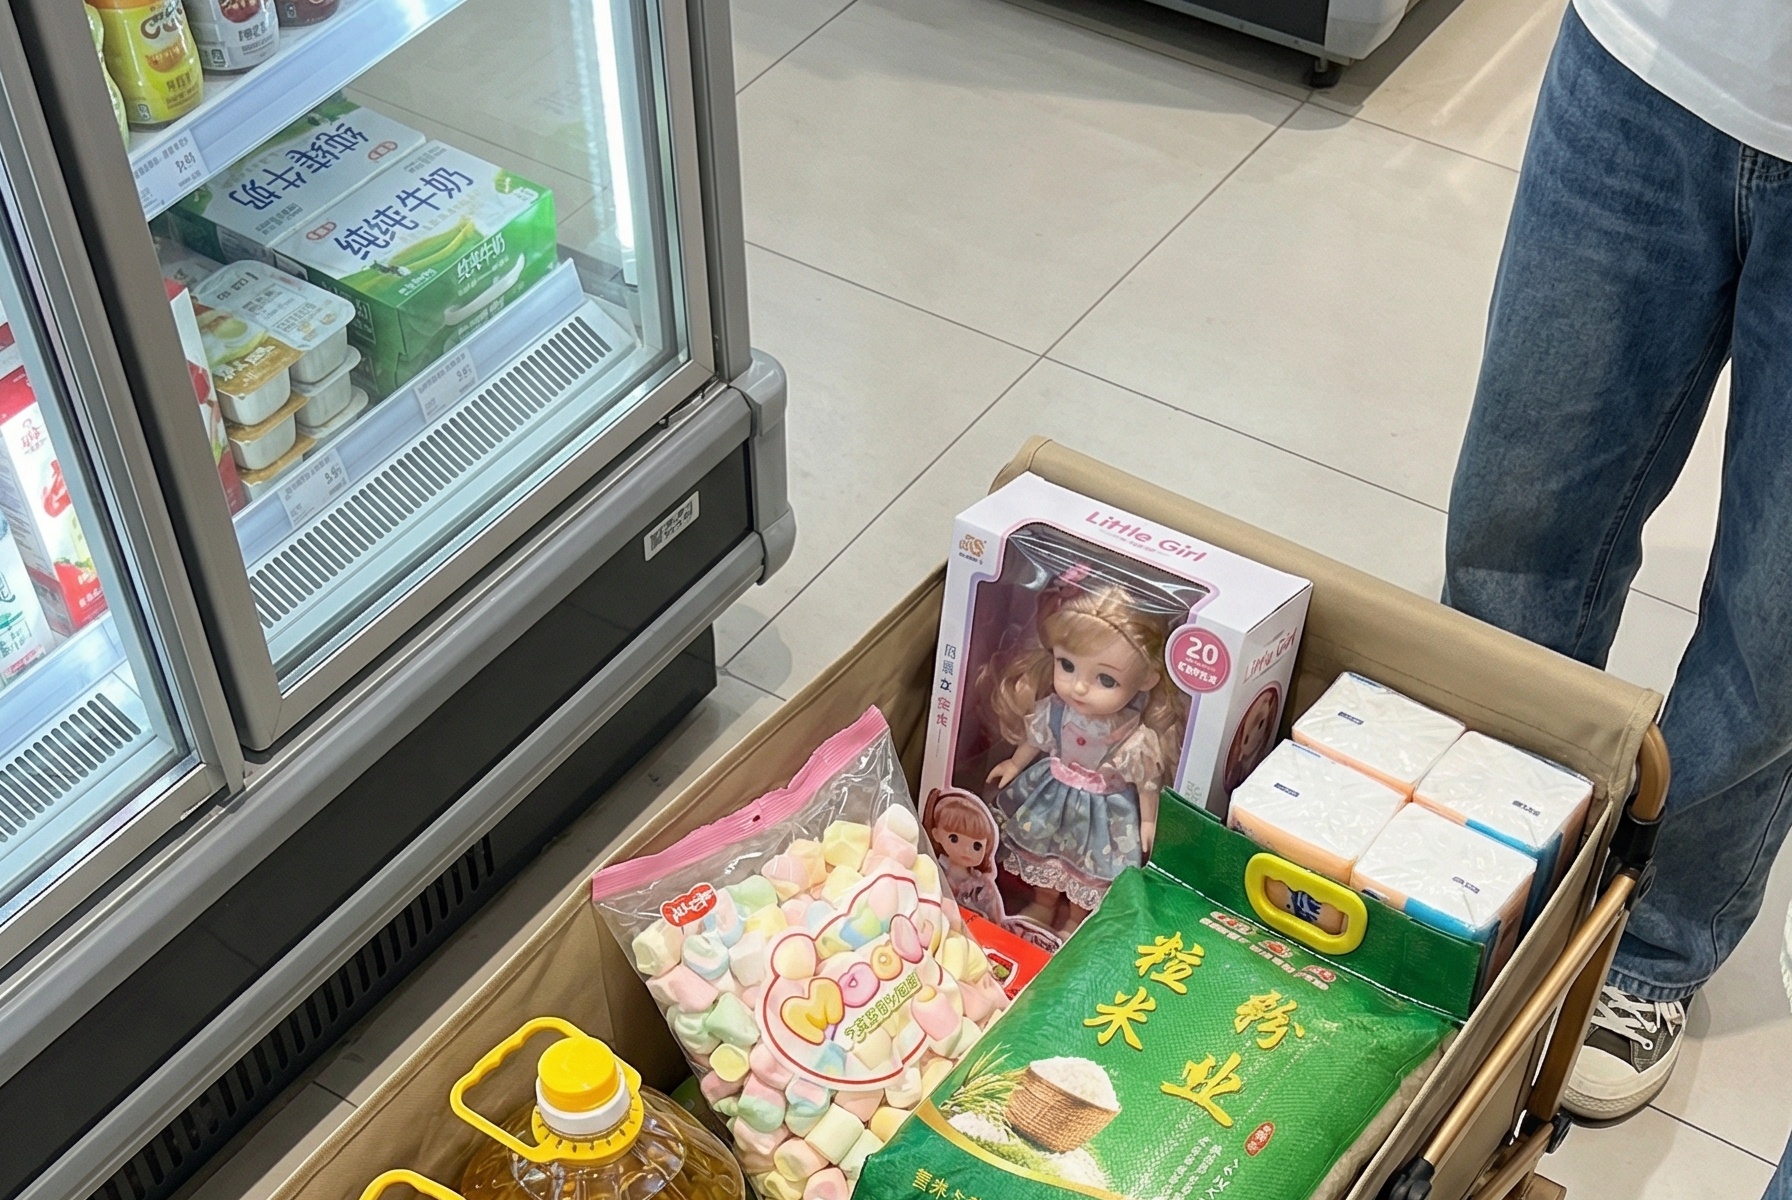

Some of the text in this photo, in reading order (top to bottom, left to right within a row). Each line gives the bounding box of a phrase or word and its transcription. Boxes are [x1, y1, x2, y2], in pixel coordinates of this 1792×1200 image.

[1085, 511, 1152, 543] Little
[1158, 539, 1207, 562] Girl
[1186, 636, 1219, 666] 20
